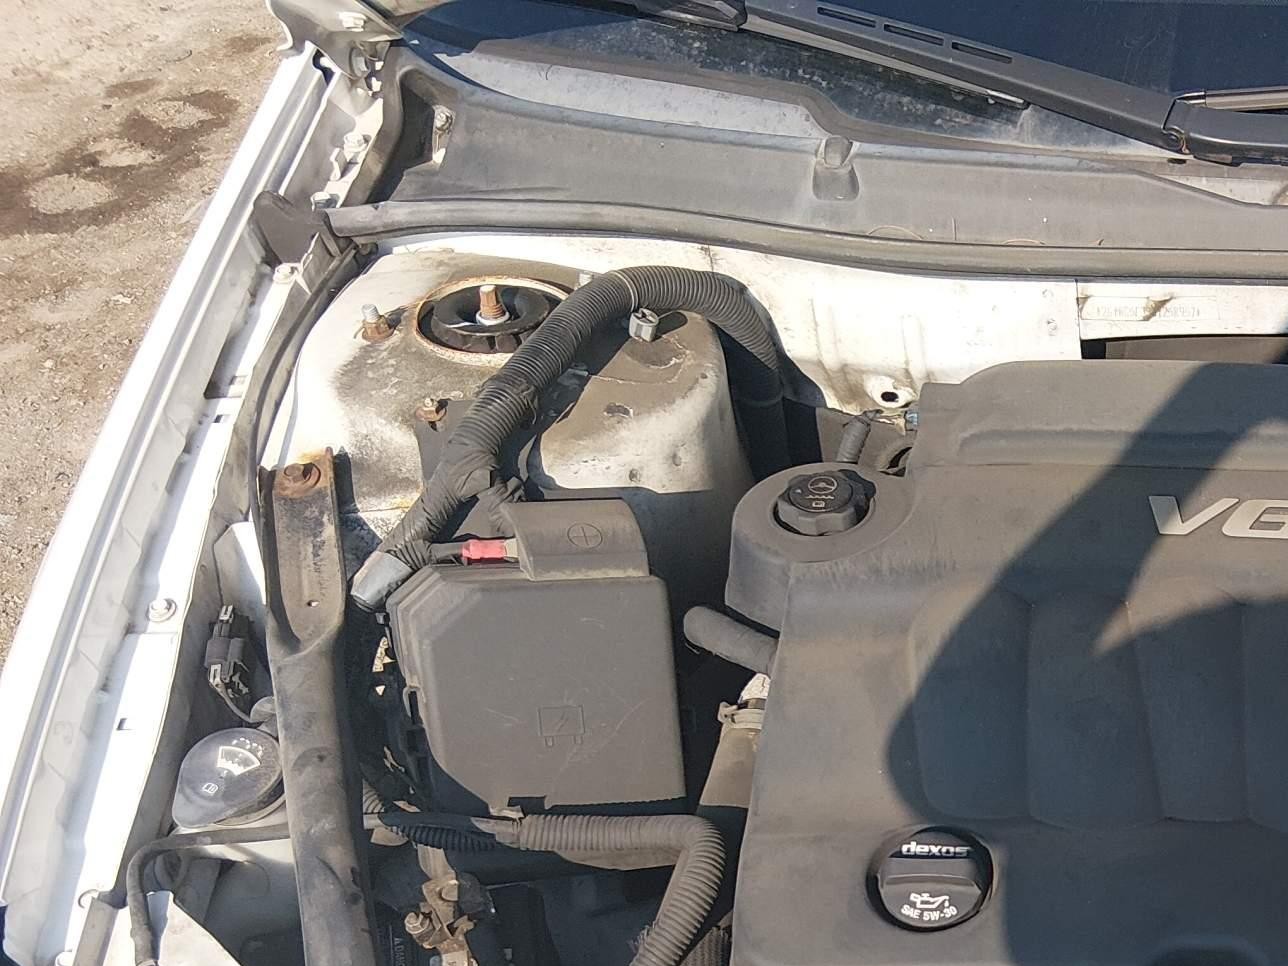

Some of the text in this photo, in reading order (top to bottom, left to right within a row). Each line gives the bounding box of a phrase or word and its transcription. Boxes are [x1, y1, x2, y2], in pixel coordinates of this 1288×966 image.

[901, 841, 975, 857] dexos
[901, 904, 958, 921] SAE 5W-30
